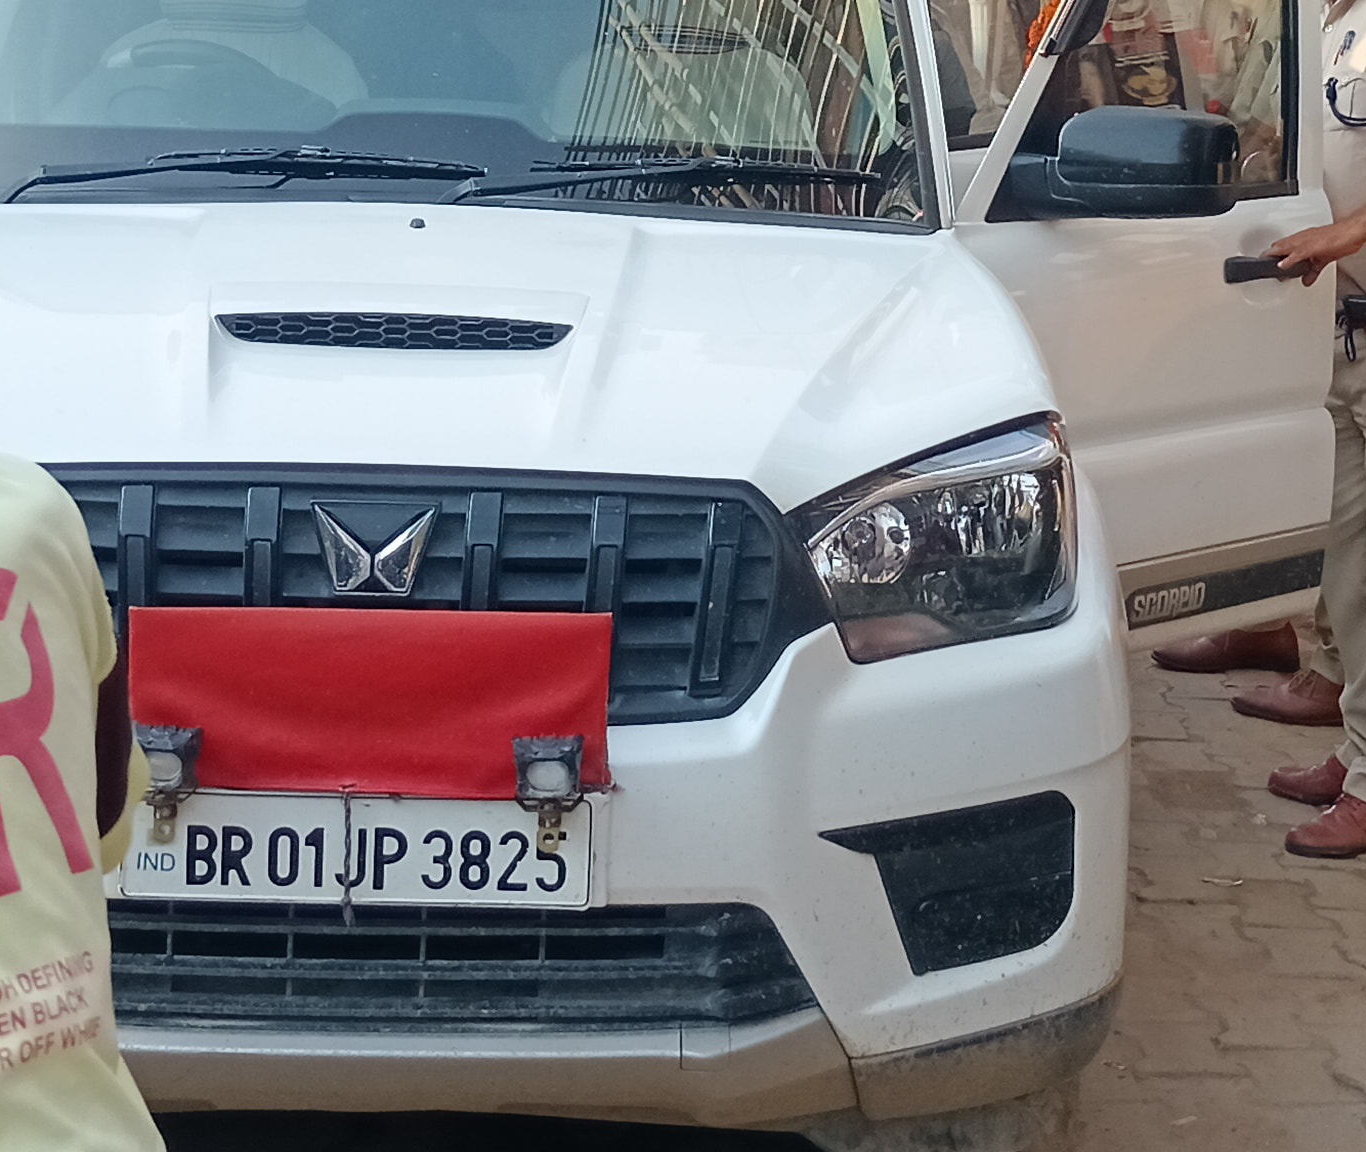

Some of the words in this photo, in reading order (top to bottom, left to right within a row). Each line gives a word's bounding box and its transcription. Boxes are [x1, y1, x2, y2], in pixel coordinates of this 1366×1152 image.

[1133, 581, 1206, 622] SCORPIO
[136, 851, 176, 873] IND
[185, 824, 254, 888] BR
[268, 827, 324, 889] 01
[335, 827, 408, 890] JP
[421, 829, 567, 893] 3825
[16, 950, 94, 994] DEFINING
[30, 986, 89, 1026] BLACK
[19, 1031, 56, 1065] OFF
